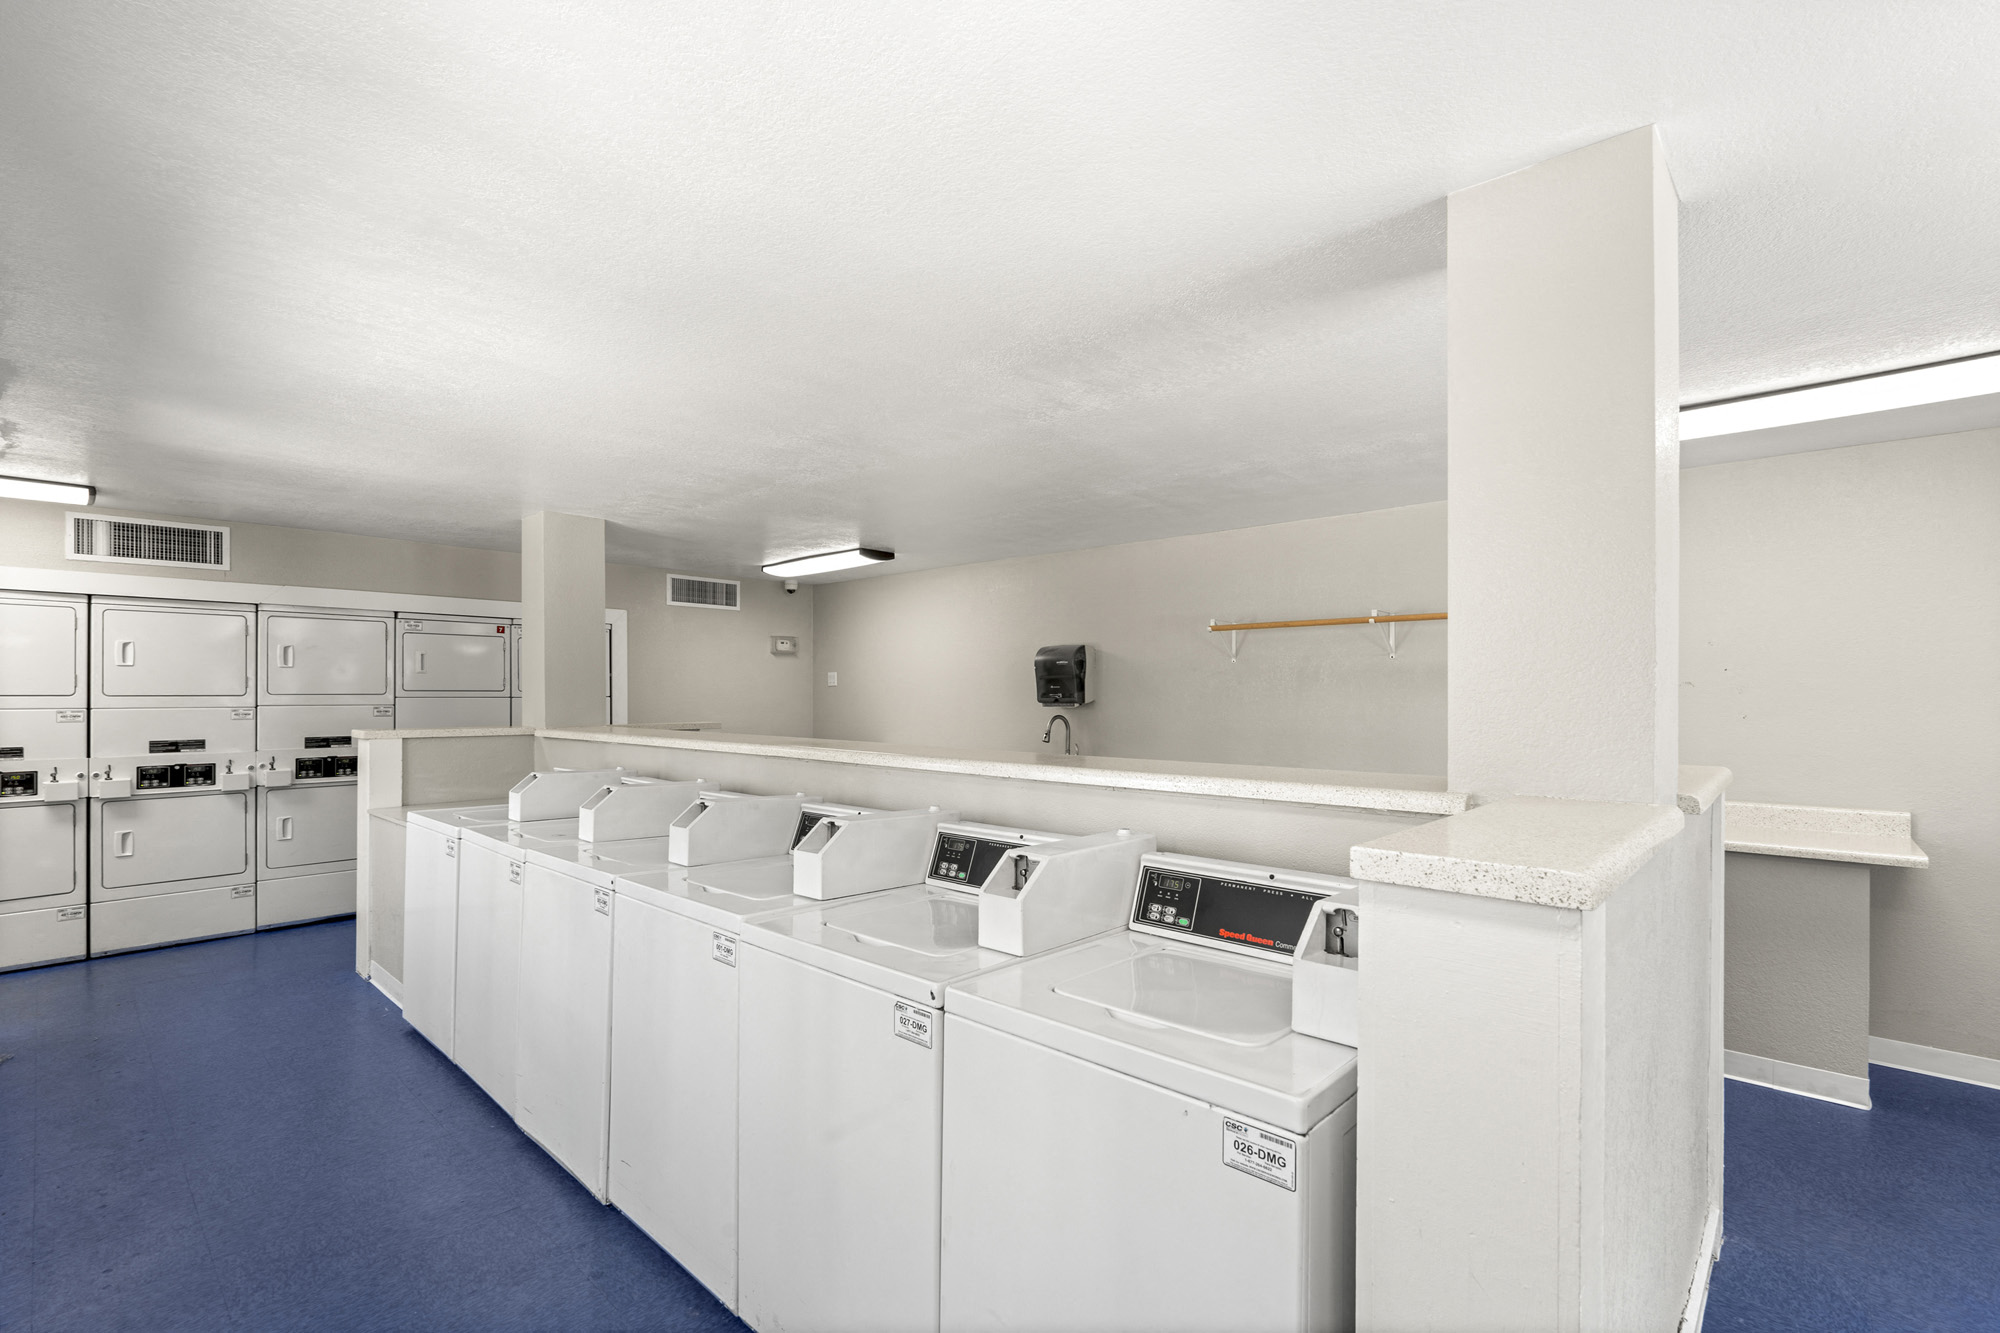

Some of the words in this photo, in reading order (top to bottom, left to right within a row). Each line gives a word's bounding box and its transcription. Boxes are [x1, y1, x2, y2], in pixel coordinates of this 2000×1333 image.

[1220, 882, 1256, 891] PERMANENT
[1218, 928, 1245, 940] Speed
[1246, 933, 1274, 946] Queen
[899, 1016, 928, 1034] 027-DMG
[1225, 1120, 1243, 1132] CSC
[1233, 1139, 1287, 1168] 026-DMG
